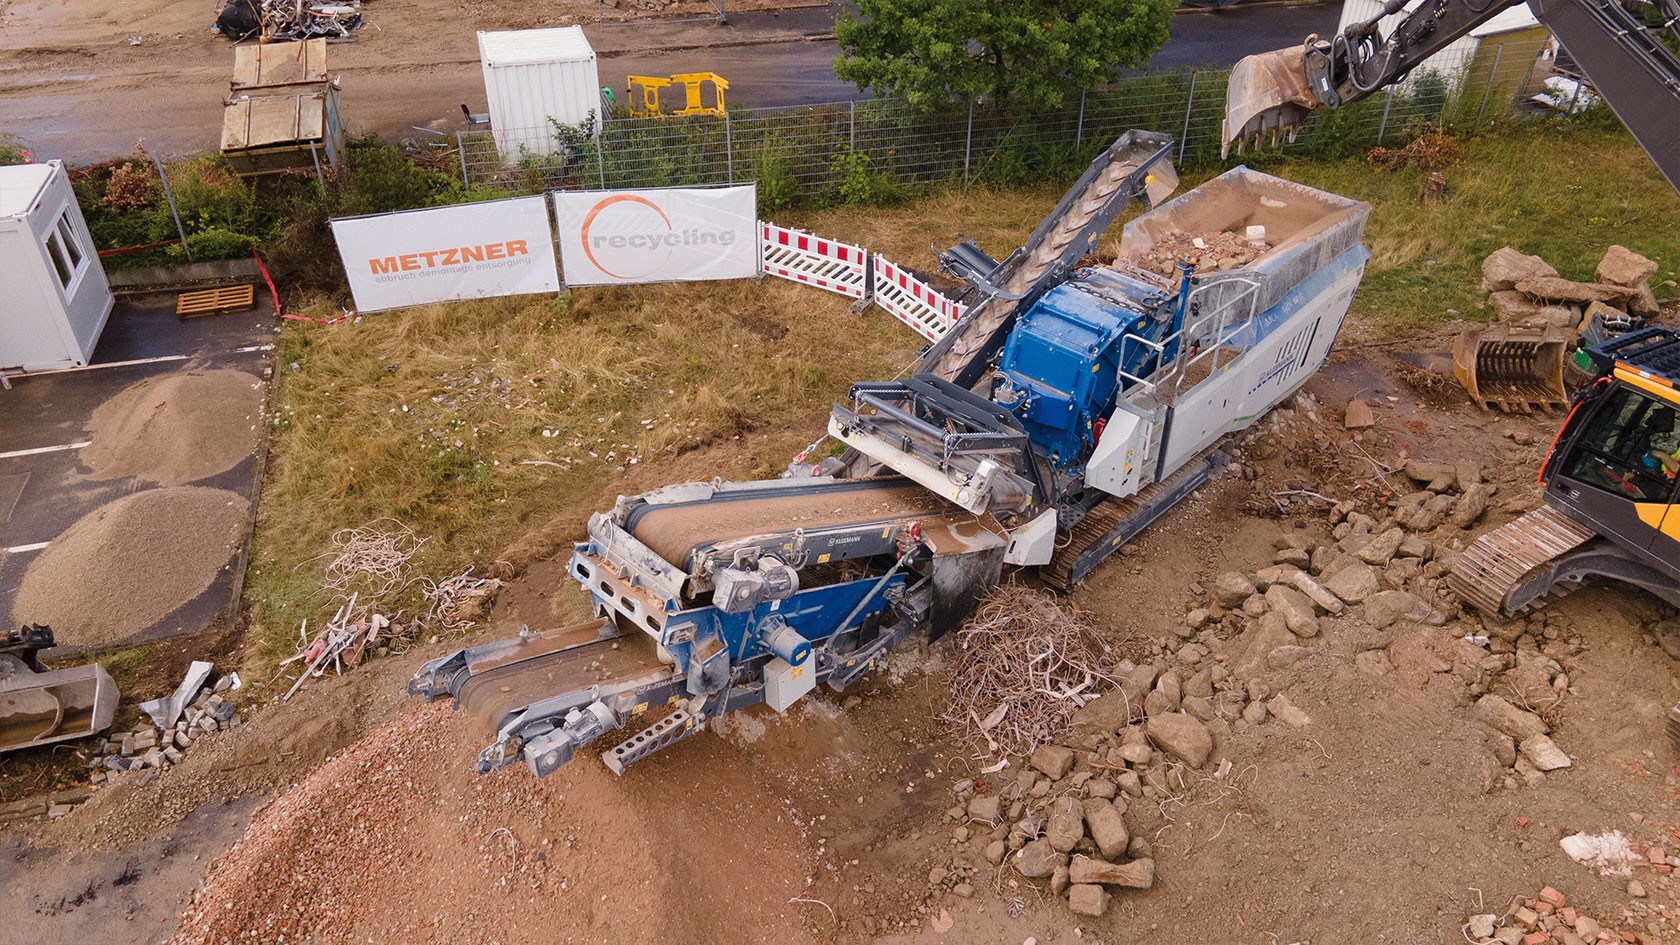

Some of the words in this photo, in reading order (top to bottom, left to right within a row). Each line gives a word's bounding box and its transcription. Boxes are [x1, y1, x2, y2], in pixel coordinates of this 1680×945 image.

[593, 229, 736, 251] recycling
[368, 239, 529, 275] METZNER
[375, 270, 417, 284] abbruch
[418, 264, 473, 279] demontage
[476, 256, 532, 271] entsorgung
